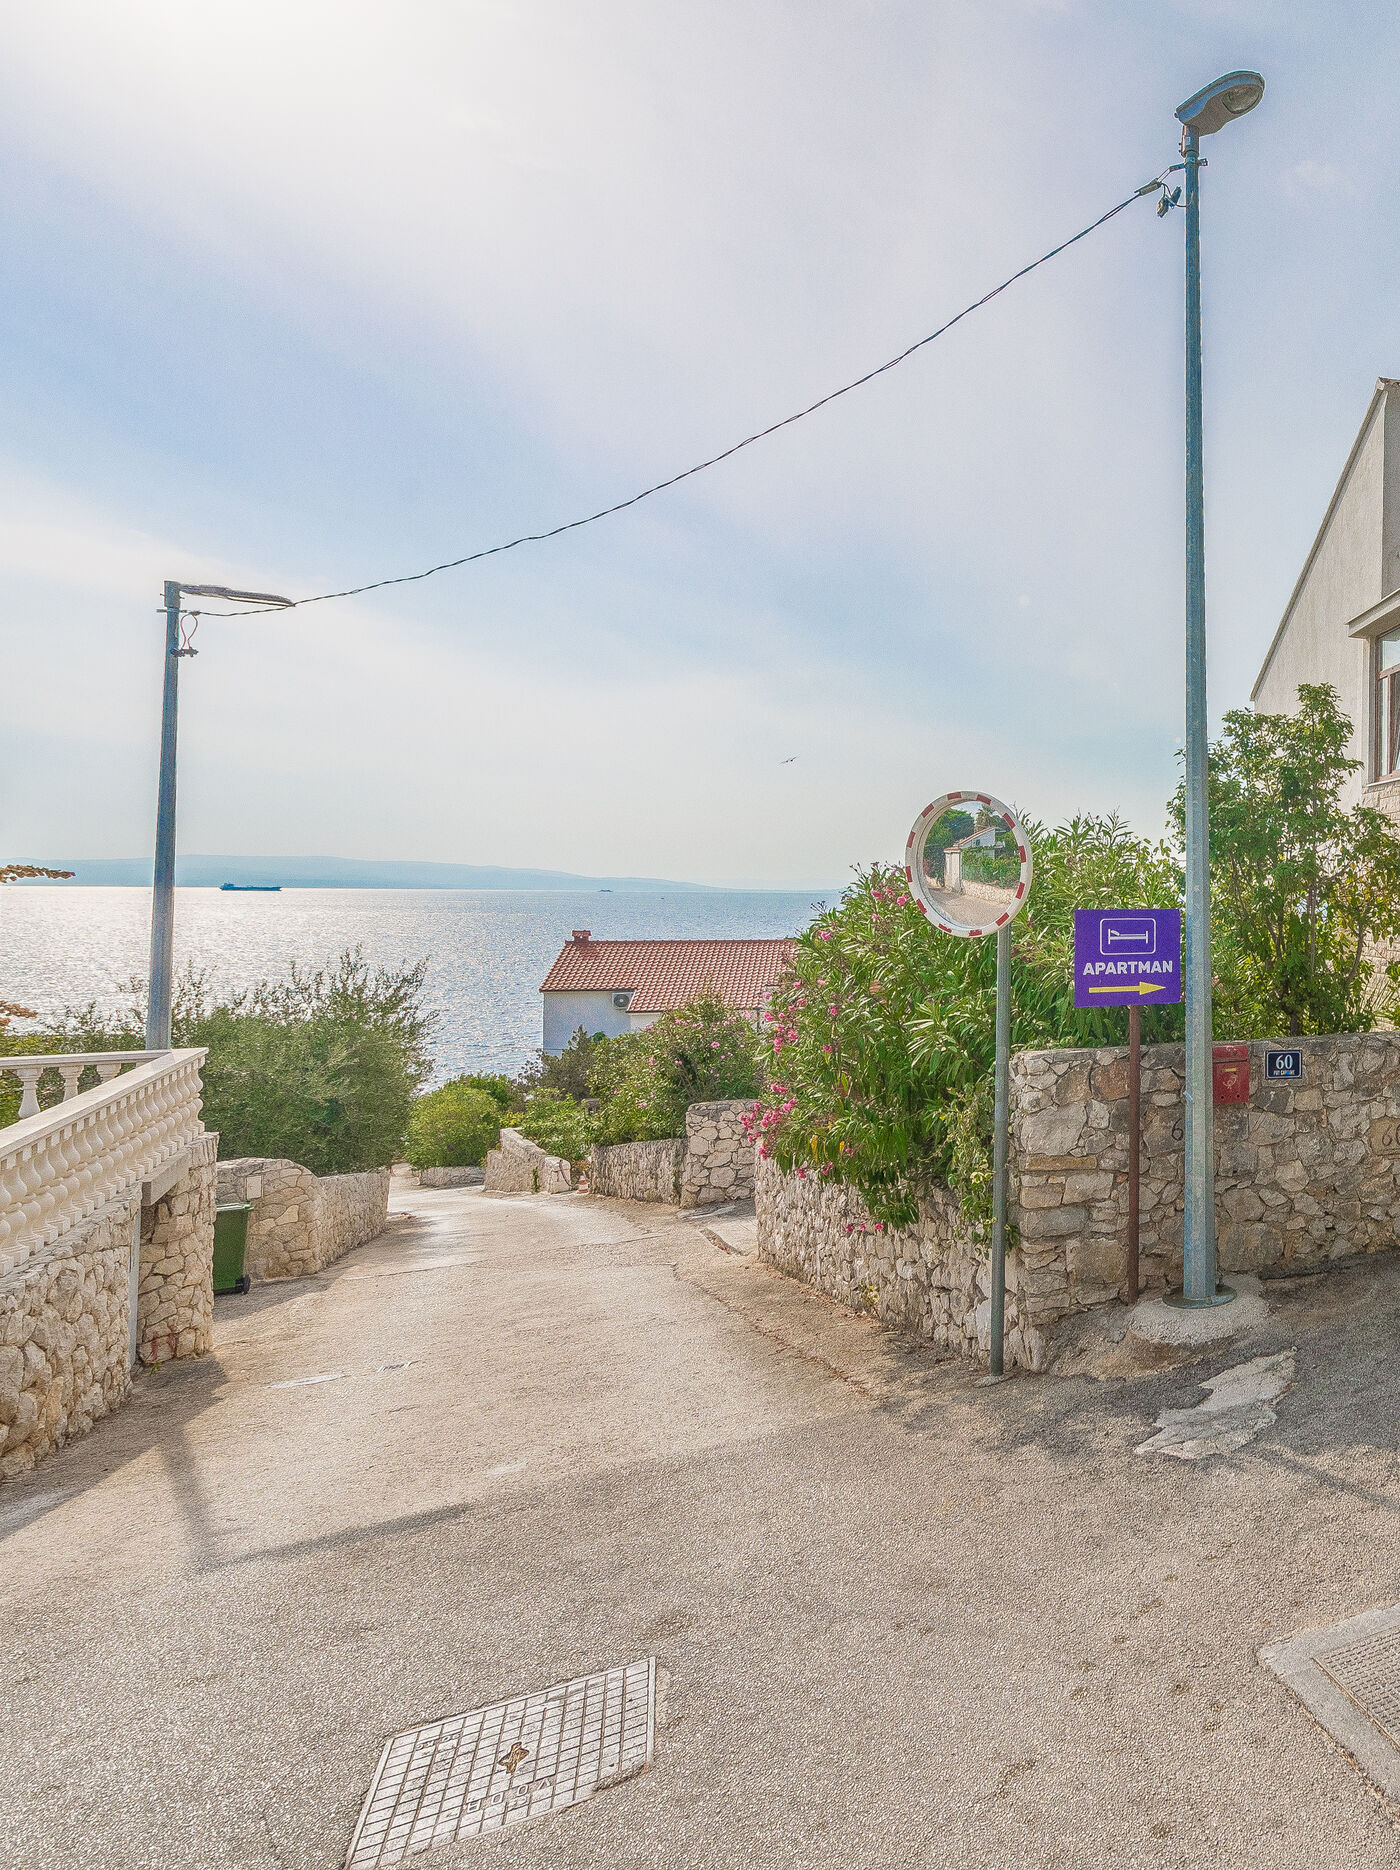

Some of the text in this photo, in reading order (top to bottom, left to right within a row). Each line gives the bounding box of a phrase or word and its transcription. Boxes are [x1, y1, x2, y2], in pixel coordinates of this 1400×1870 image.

[1083, 960, 1173, 976] APARTMAN
[1275, 1054, 1294, 1070] 60
[464, 1777, 553, 1813] VODA
